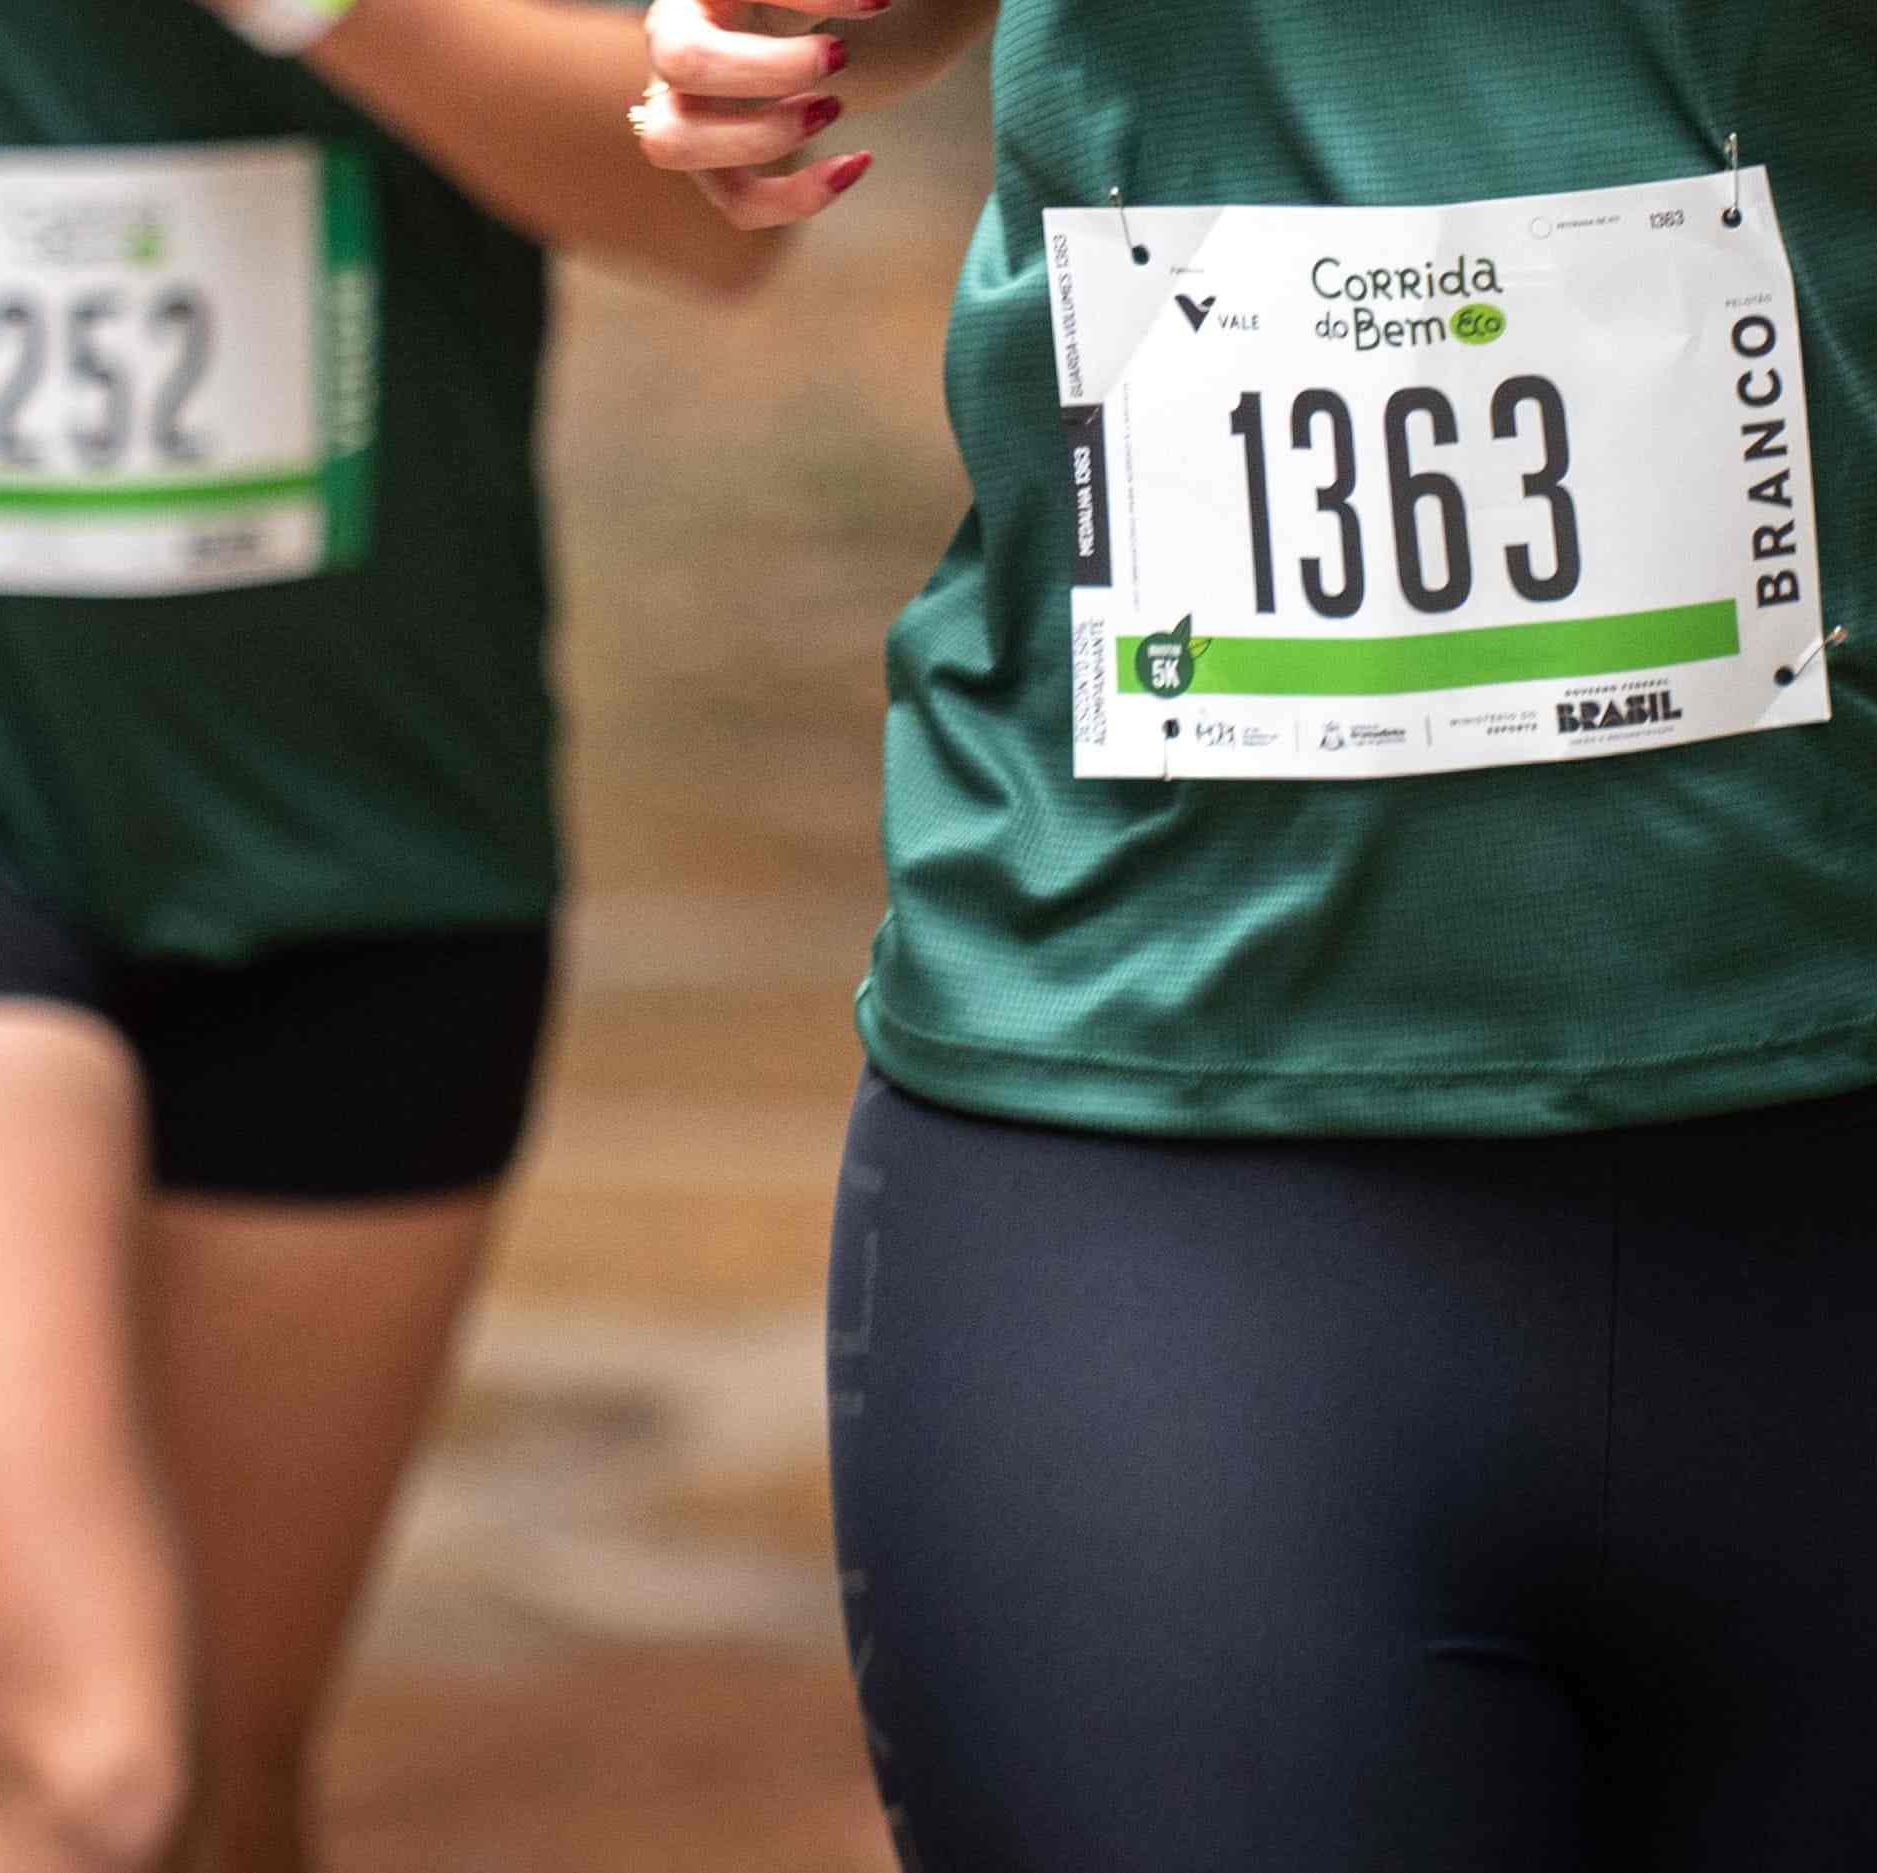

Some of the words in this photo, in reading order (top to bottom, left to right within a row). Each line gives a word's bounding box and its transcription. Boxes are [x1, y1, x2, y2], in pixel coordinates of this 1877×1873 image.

[1217, 313, 1260, 332] VALE
[1315, 311, 1349, 340] do
[1353, 306, 1448, 352] Bem
[1454, 308, 1503, 338] Eco
[1730, 314, 1802, 609] BRANCO
[1229, 373, 1582, 620] 1363
[1151, 658, 1181, 690] 5K
[1556, 690, 1684, 734] BRASIL
